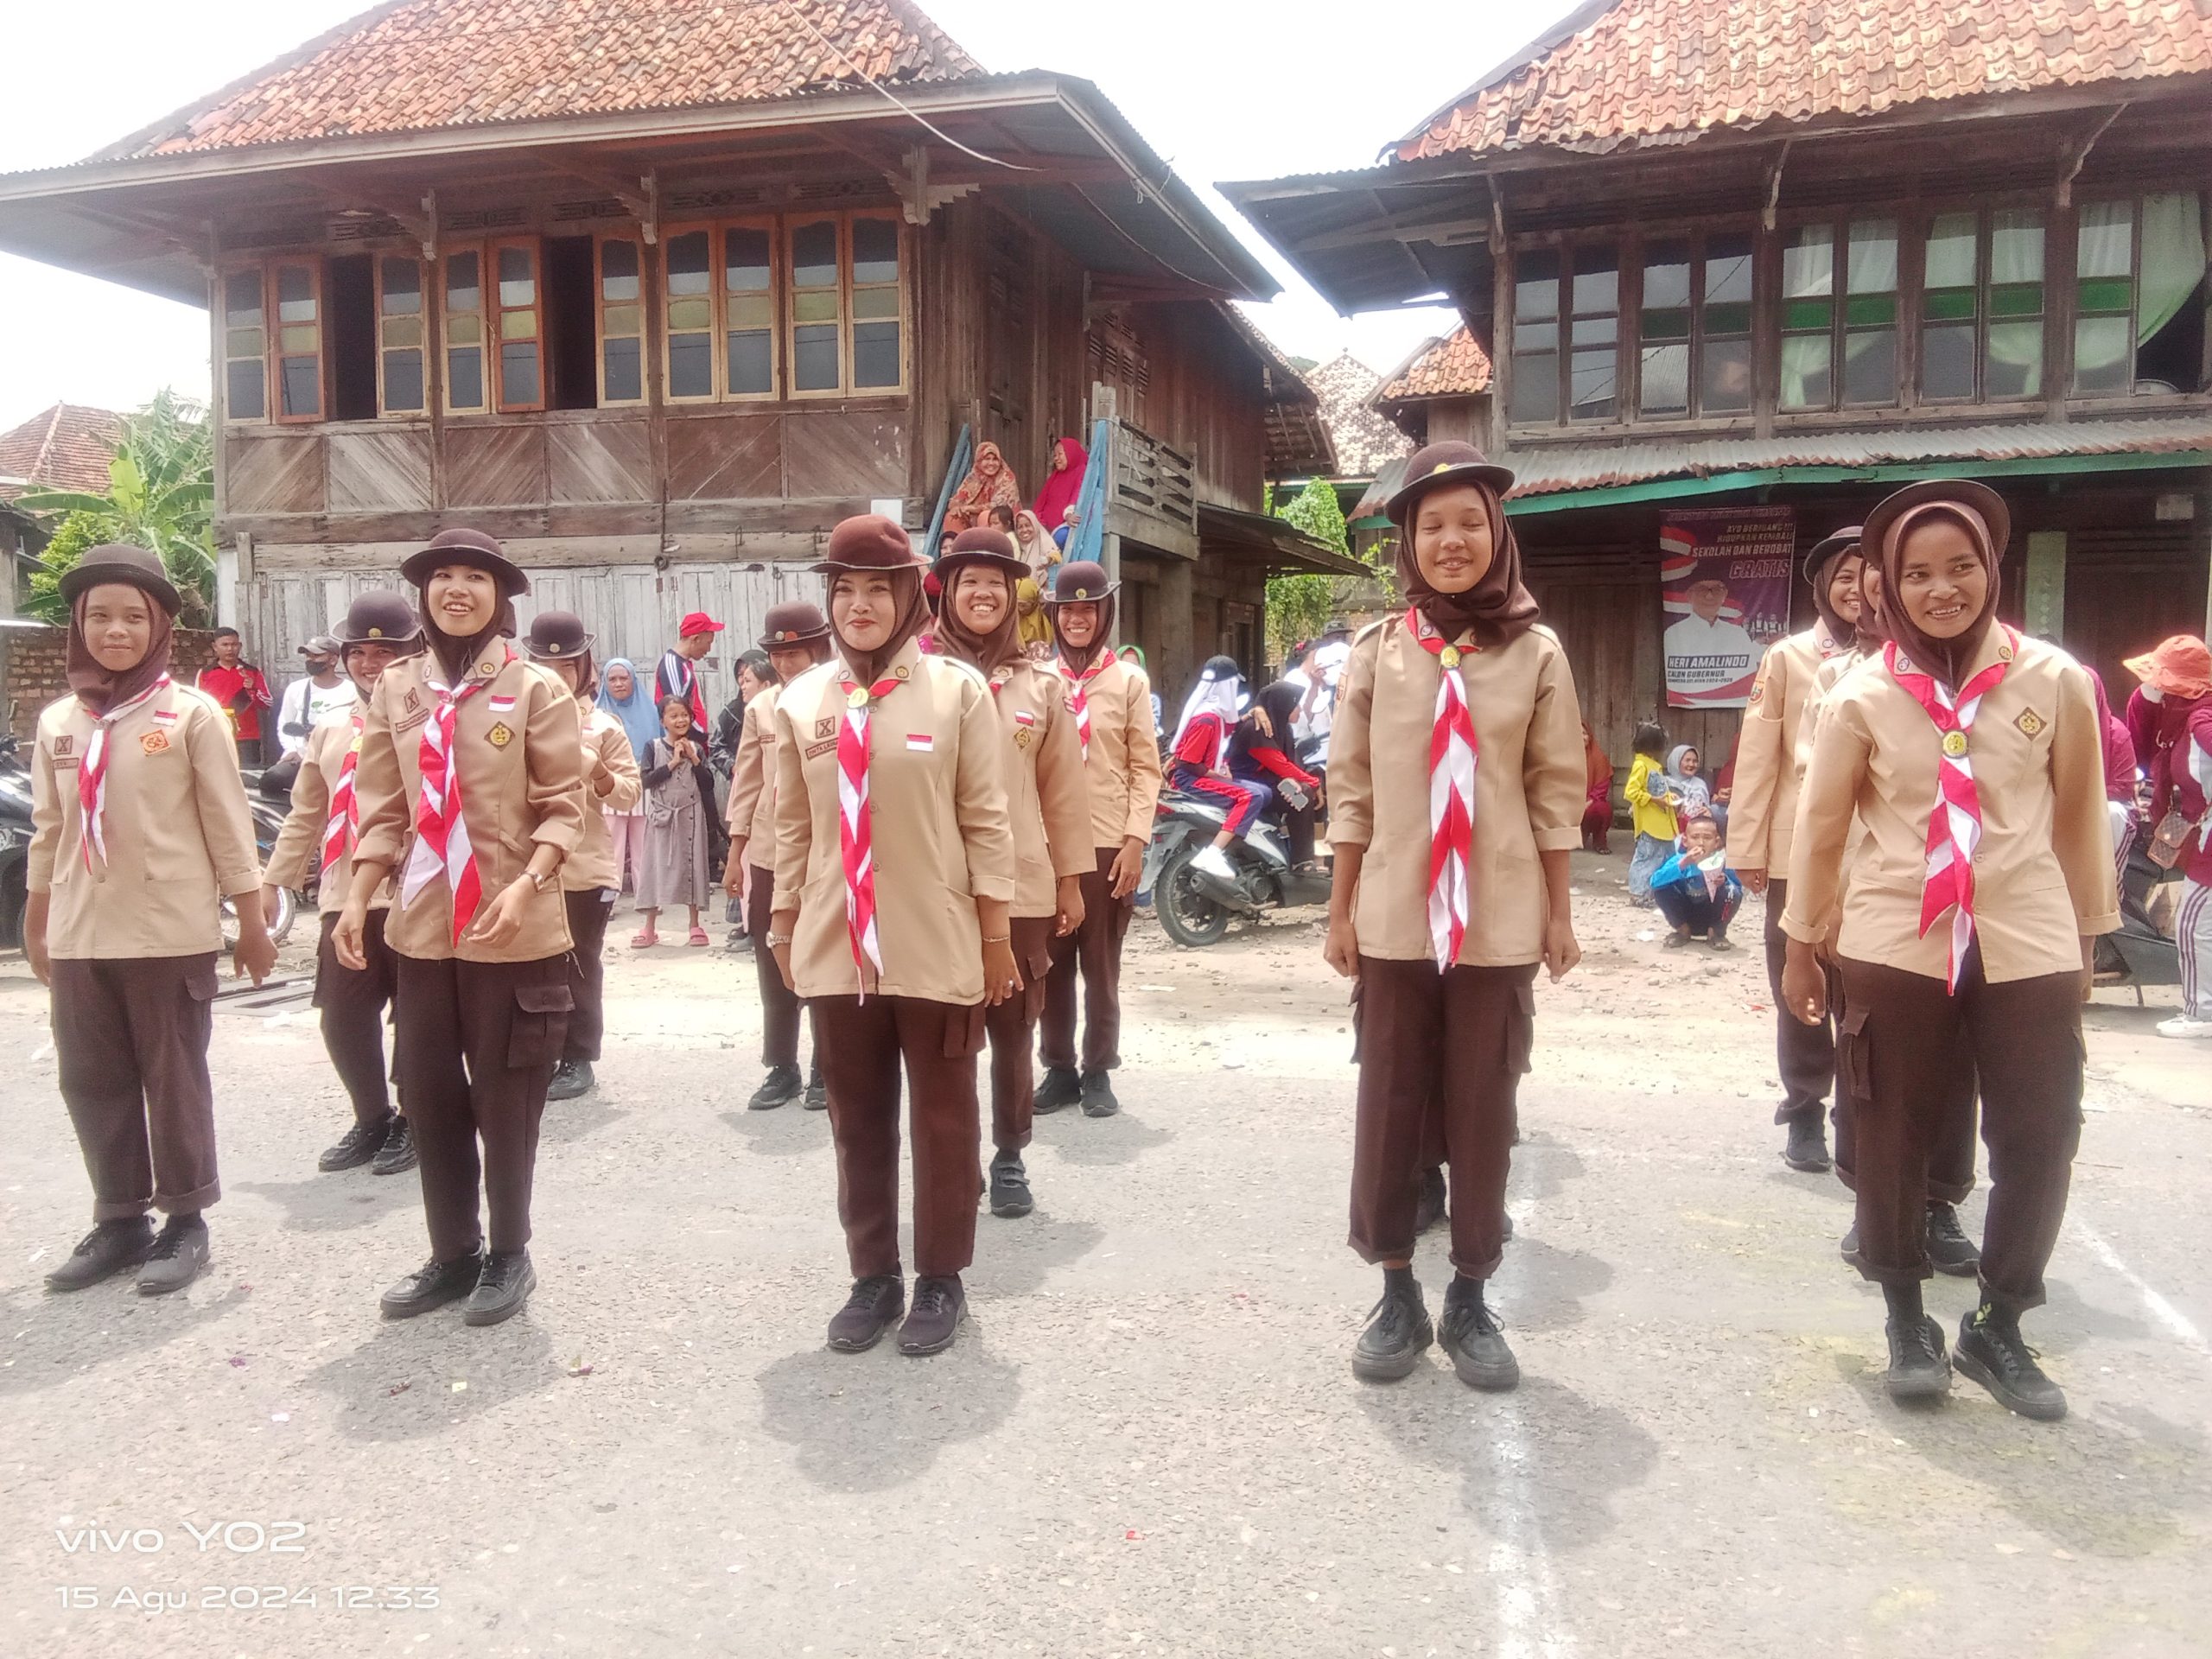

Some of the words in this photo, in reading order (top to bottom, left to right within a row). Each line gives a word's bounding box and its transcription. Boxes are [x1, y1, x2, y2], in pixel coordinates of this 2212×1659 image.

[1692, 545, 1732, 557] SEKOLAH
[1732, 544, 1751, 556] DAN
[1752, 543, 1792, 555] BEROBAT
[1729, 559, 1791, 580] GRATIS
[1669, 657, 1688, 668] HERI
[1690, 656, 1748, 668] AMALINDO
[819, 720, 831, 735] X
[58, 739, 67, 752] X
